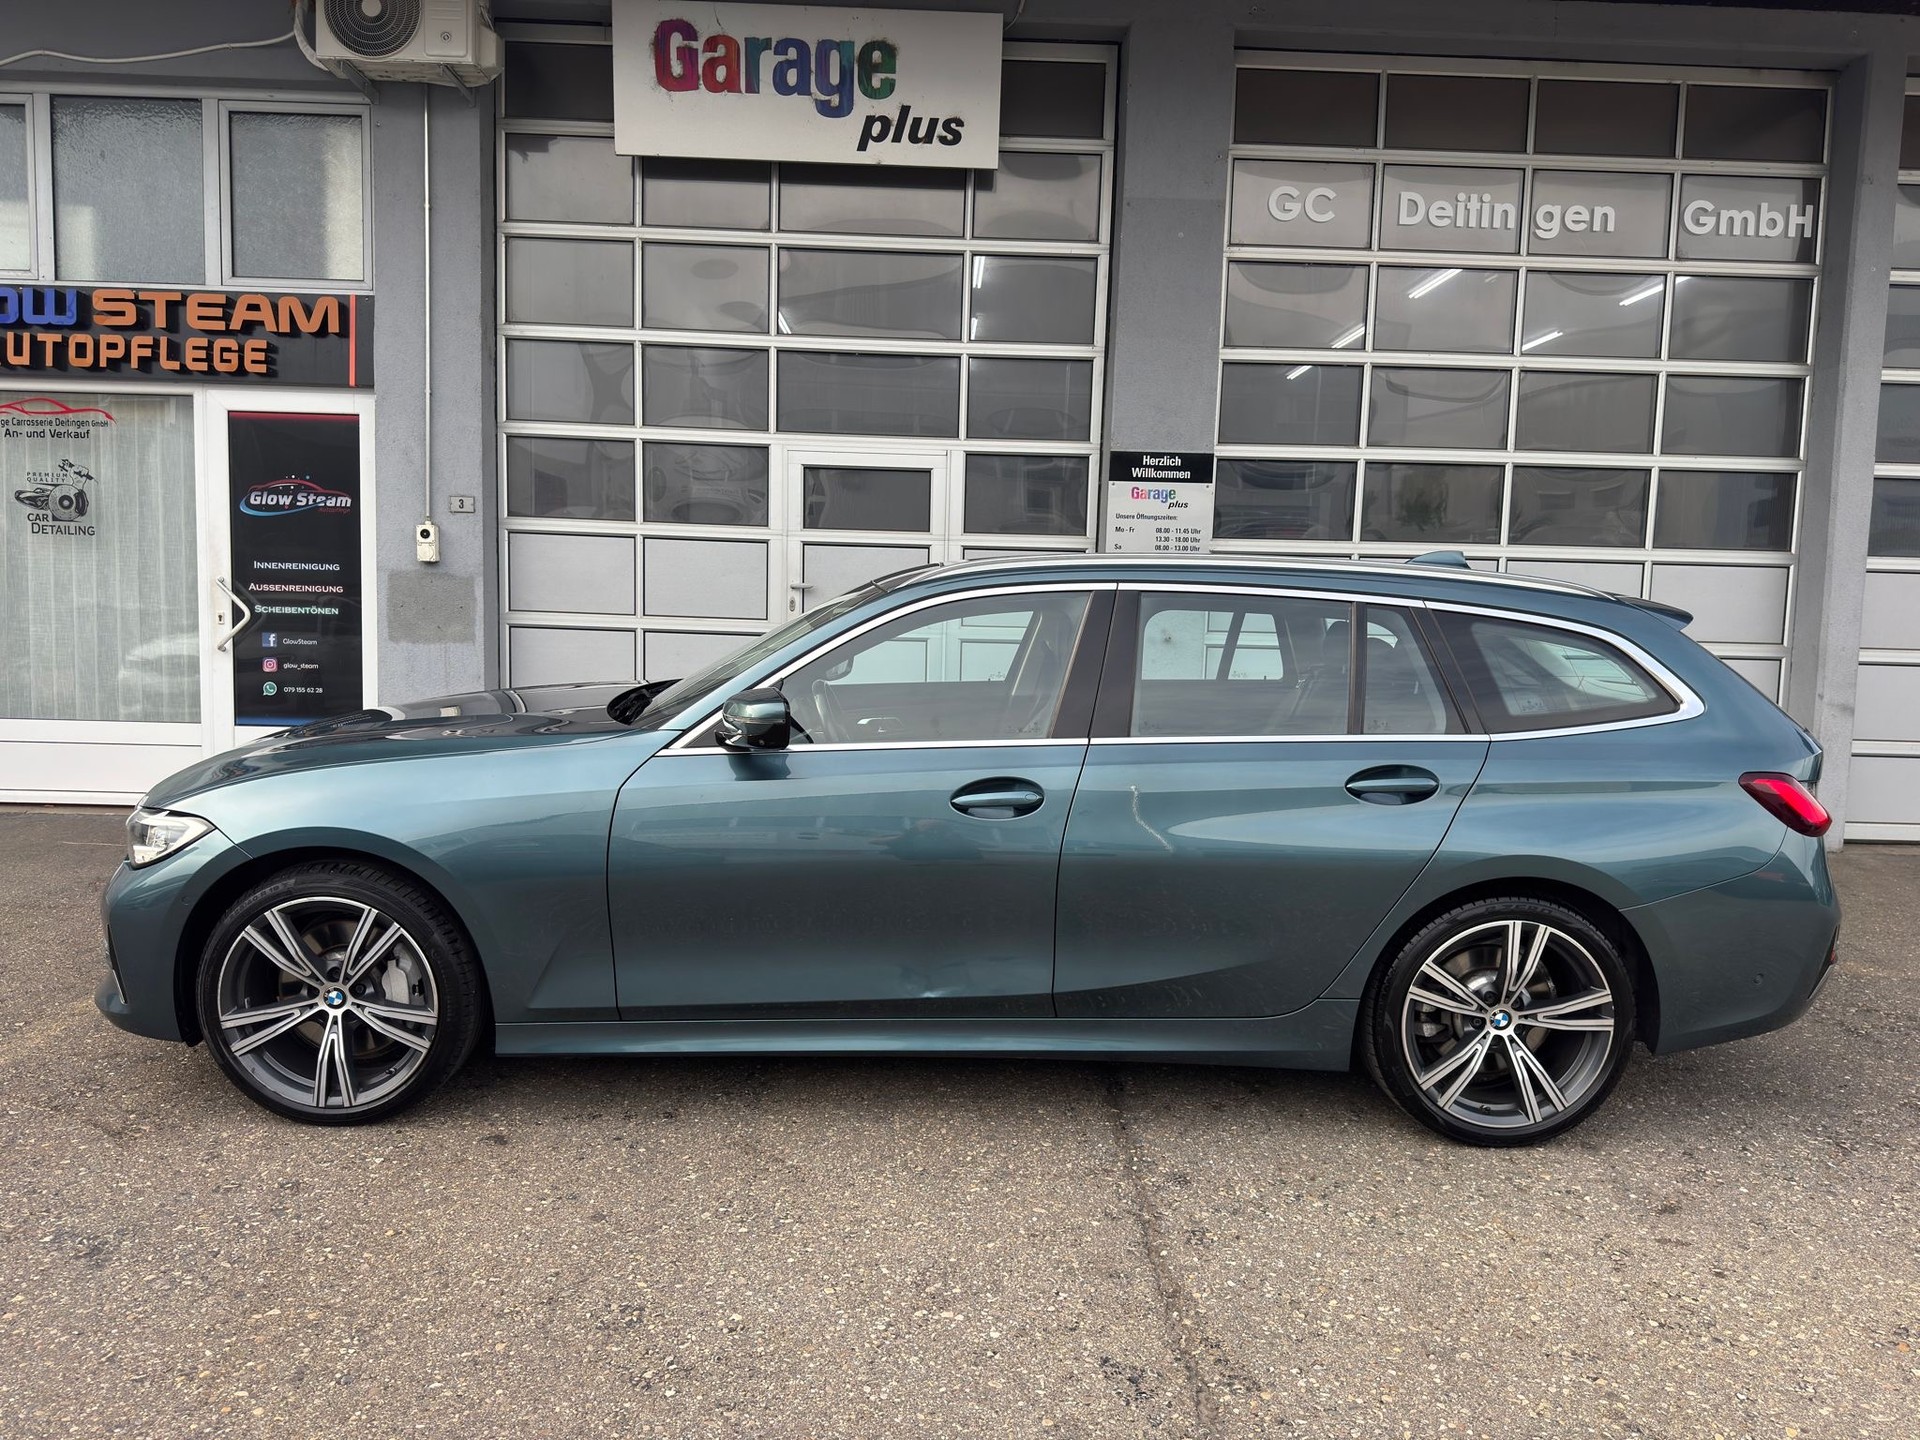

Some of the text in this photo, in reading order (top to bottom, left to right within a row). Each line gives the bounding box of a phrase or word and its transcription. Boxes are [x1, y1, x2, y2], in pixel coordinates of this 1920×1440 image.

[654, 18, 897, 118] Garage
[856, 105, 965, 152] plus
[1268, 186, 1337, 222] GC
[1683, 200, 1814, 238] GmbH
[92, 288, 340, 334] STEAM
[11, 417, 53, 427] Carrosserie
[55, 417, 90, 429] Deitingen
[4, 428, 91, 439] An- und Verkauf
[1142, 455, 1181, 466] Herzlich
[1131, 467, 1191, 479] Willkommen
[250, 491, 352, 508] Glow Steam
[1131, 487, 1176, 503] Garage
[458, 499, 464, 509] 3
[1168, 501, 1189, 509] plus
[27, 513, 49, 522] CAR
[31, 522, 96, 536] DETAILING
[253, 560, 341, 571] INNENREINIGUNG
[248, 582, 344, 594] AUSSENREINIGUNG
[282, 637, 318, 646] GlowSteam
